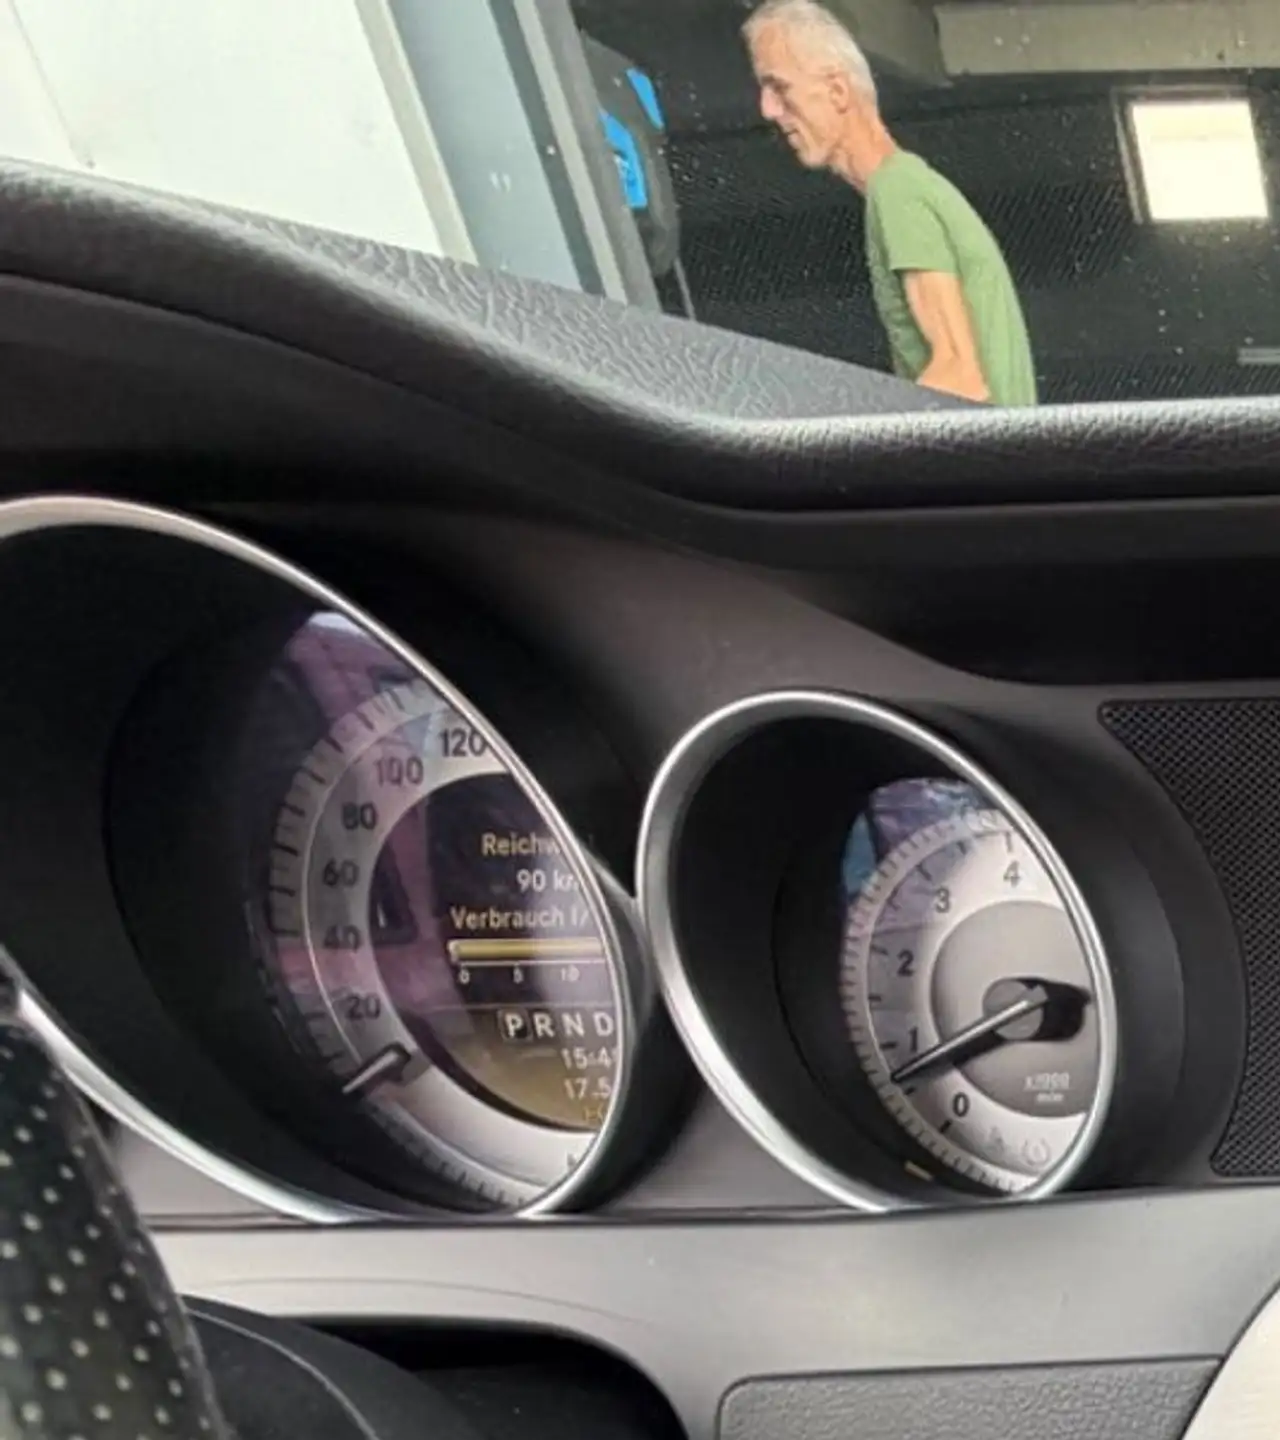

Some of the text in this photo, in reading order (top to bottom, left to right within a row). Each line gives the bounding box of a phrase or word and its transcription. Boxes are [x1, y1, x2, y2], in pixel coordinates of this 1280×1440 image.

[439, 727, 489, 757] 120
[378, 757, 424, 786] 100
[343, 803, 377, 830] 80
[323, 858, 358, 887] 60
[516, 868, 546, 893] 90
[1003, 862, 1020, 887] 4
[936, 888, 951, 913] 3
[450, 907, 564, 932] Verbrauch
[898, 951, 914, 976] 2
[347, 993, 380, 1019] 20
[504, 1011, 614, 1038] P R N D
[908, 1029, 918, 1052] 1
[953, 1094, 968, 1117] 0
